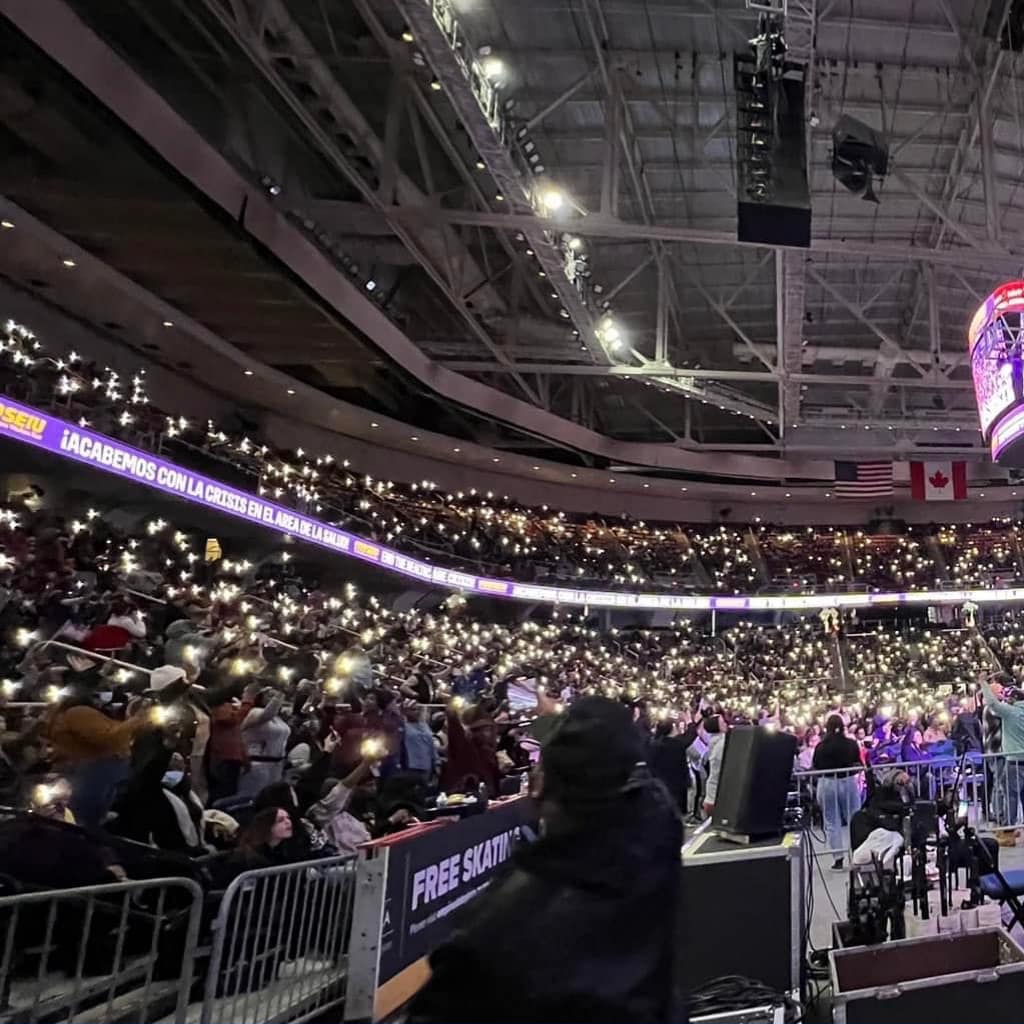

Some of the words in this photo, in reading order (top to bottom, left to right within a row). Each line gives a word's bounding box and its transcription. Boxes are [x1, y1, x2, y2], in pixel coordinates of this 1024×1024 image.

[0, 405, 46, 434] SEIU
[60, 429, 156, 481] ¡ACABEMOS
[156, 466, 187, 493] CON
[187, 477, 204, 499] LA
[204, 485, 248, 514] CRISIS
[248, 503, 262, 519] EN
[411, 853, 461, 911] FREE
